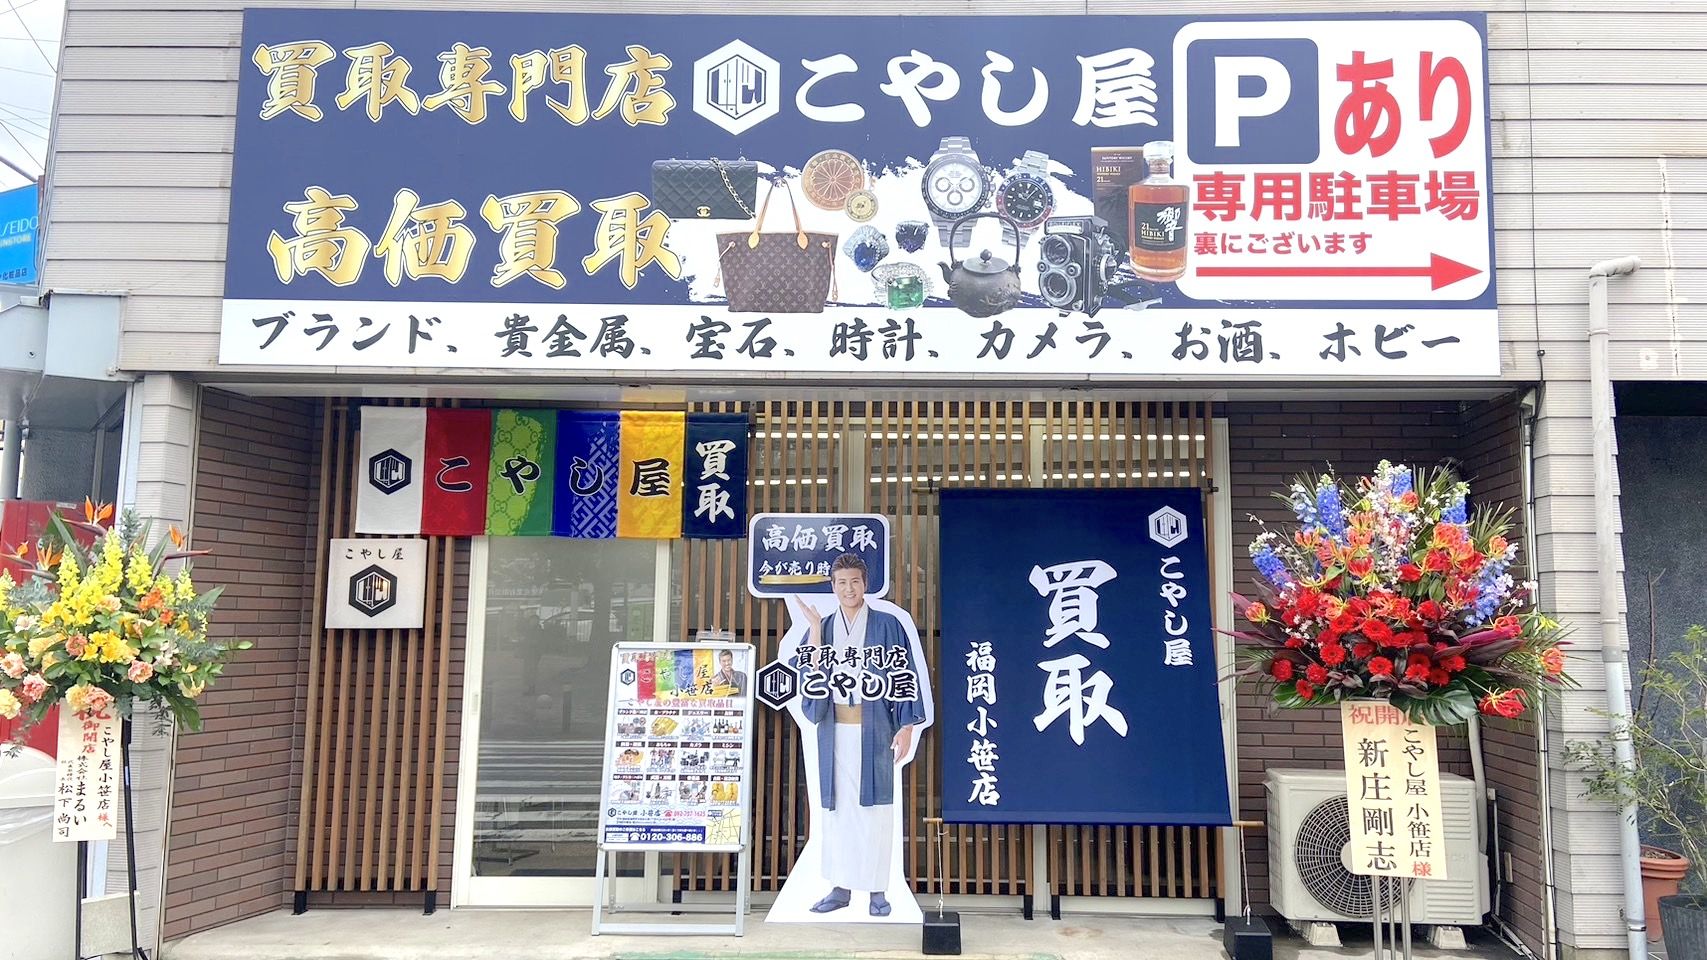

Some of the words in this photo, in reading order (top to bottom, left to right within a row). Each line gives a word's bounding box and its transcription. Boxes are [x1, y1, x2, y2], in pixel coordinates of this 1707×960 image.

[253, 40, 677, 127] 買取専門店
[796, 47, 1158, 128] こやし屋
[1214, 56, 1291, 147] P
[1334, 50, 1472, 158] あり
[1193, 171, 1480, 221] 専用駐車場
[266, 186, 682, 289] 高価買取
[1193, 232, 1373, 255] 裏にございます
[435, 455, 671, 498] こやし屋
[694, 439, 737, 524] 買取
[345, 547, 404, 560] こやし屋
[758, 560, 832, 577] 今が売り時
[761, 523, 878, 553] 高価買取
[1160, 556, 1194, 666] こやし屋
[795, 645, 909, 669] 買取専門店
[1028, 559, 1128, 746] 買取
[670, 681, 714, 697] 小笹店
[803, 671, 918, 701] こやし屋
[966, 641, 1000, 806] 福岡小笹店
[1402, 729, 1428, 796] こやし屋
[57, 782, 74, 837] 松下尚司
[1357, 738, 1397, 870] 新庄剛志
[640, 833, 703, 841] 0120-306-886
